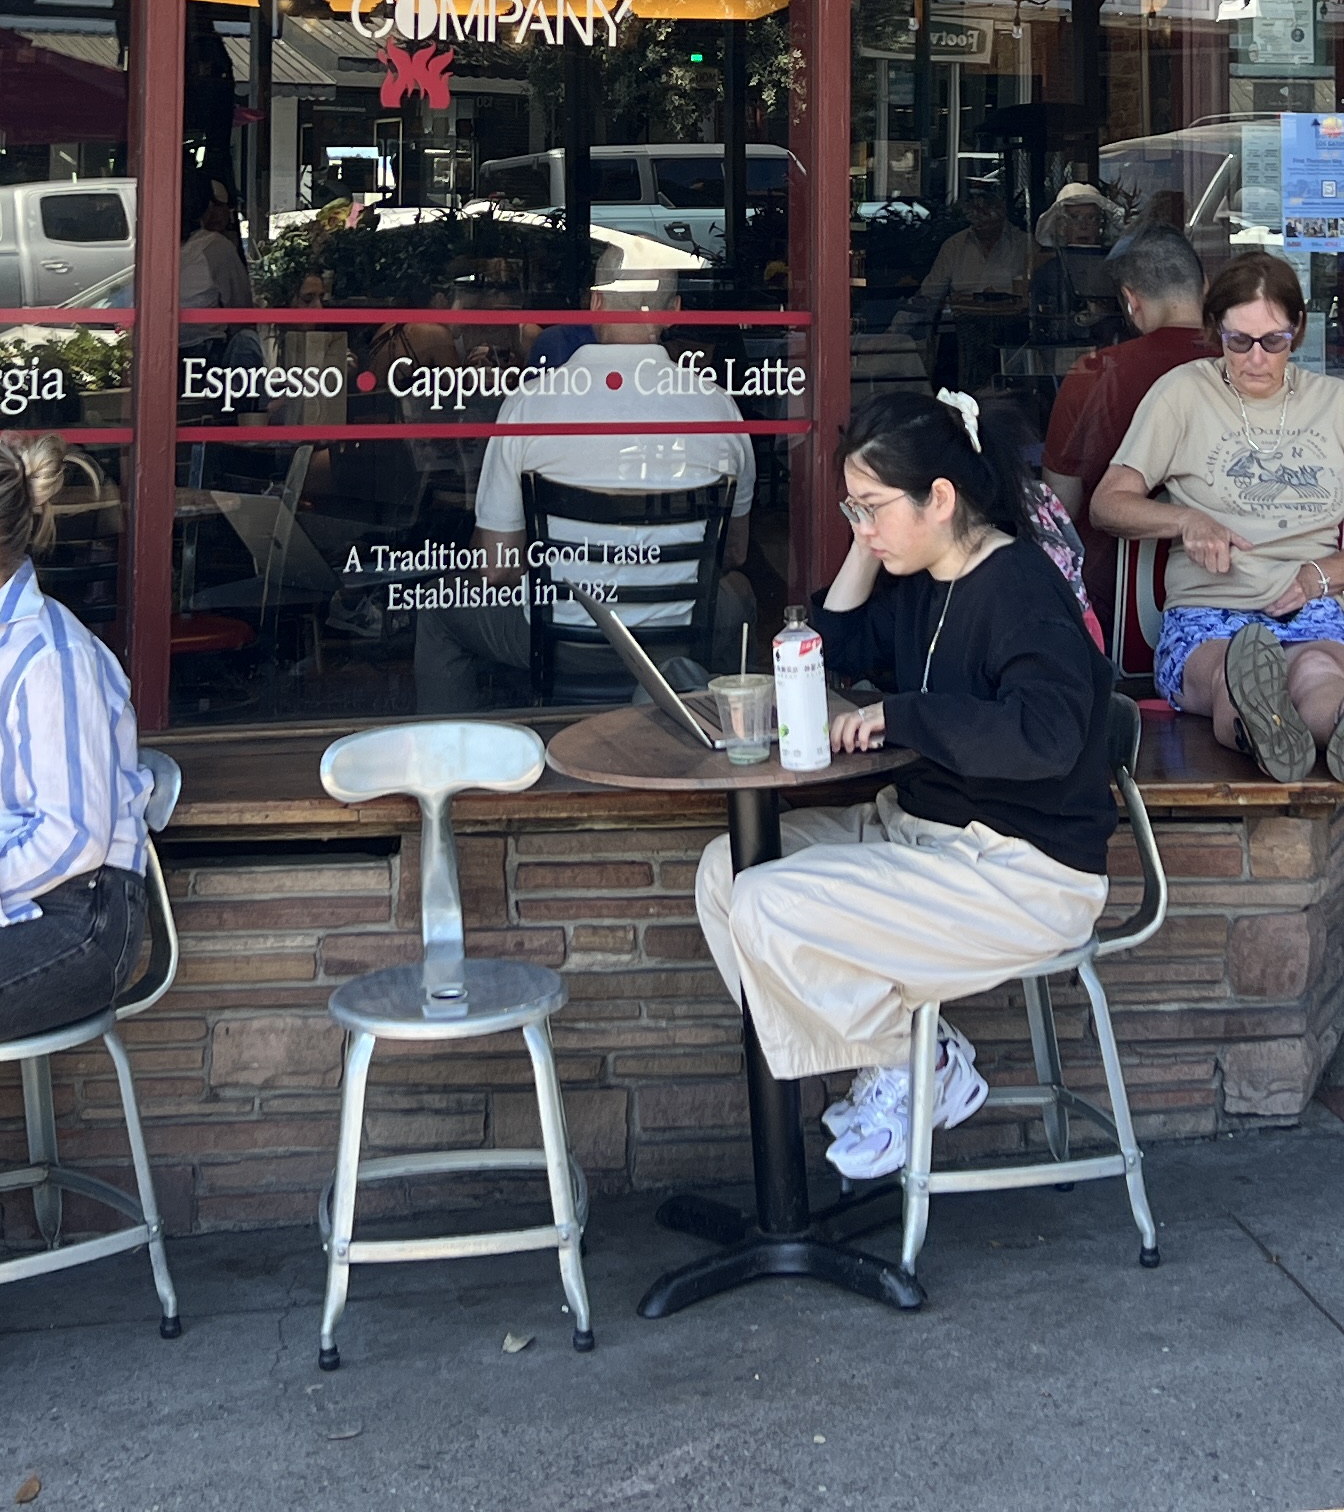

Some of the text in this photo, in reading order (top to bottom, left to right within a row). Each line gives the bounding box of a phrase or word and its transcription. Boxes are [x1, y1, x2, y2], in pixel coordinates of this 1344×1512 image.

[181, 351, 807, 411] Espresso Cappuccino Caffe Latte
[342, 537, 661, 573] A Tradition In Good Taste
[387, 576, 527, 611] Established
[534, 578, 558, 605] in
